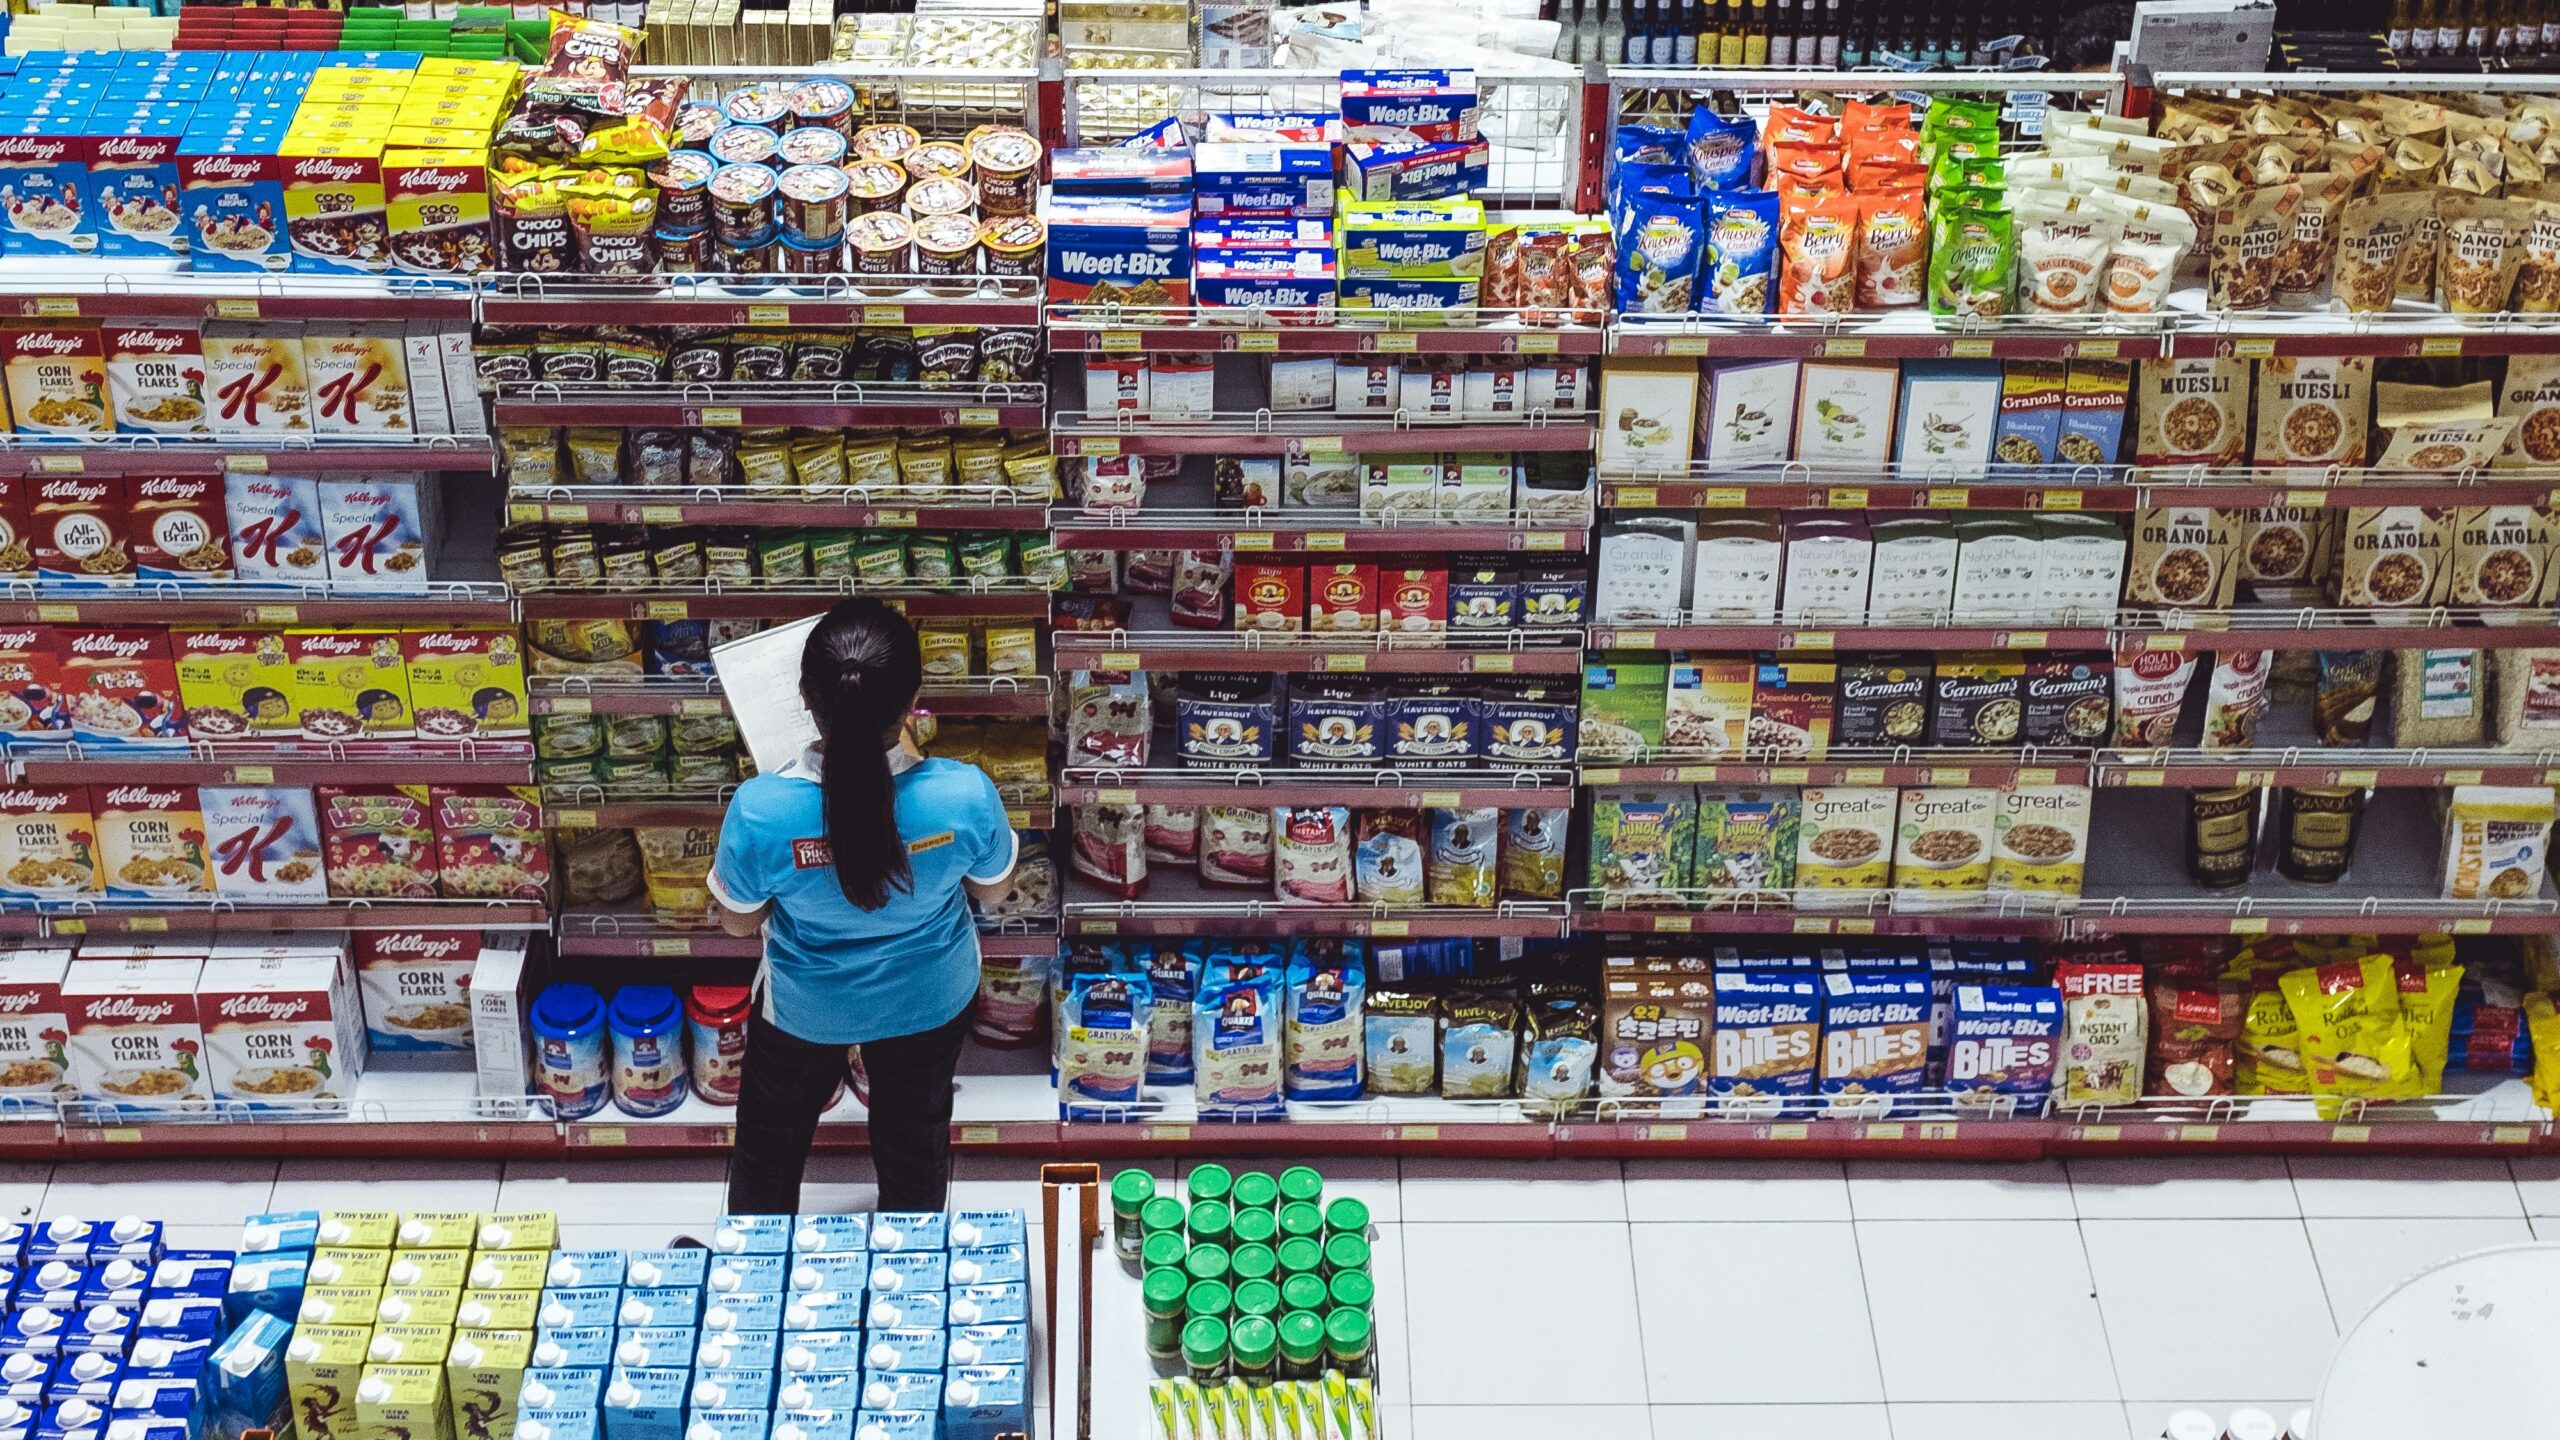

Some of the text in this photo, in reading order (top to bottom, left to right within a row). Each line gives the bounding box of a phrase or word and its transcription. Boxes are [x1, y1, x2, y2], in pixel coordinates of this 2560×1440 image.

[572, 32, 619, 48] CHOCO
[564, 40, 620, 65] CHIPS
[534, 92, 562, 104] Tinggi
[1369, 104, 1450, 122] Weet-Bix
[1234, 116, 1315, 130] Weet-Bix
[99, 138, 166, 160] Kellogg's
[193, 156, 261, 178] Kellogg's
[295, 158, 363, 180] Kellogg's
[400, 168, 468, 190] Kellogg's
[314, 192, 356, 204] COCO
[1232, 193, 1295, 207] Weet-Bix
[418, 203, 460, 215] COCO
[516, 218, 563, 230] CHOCO
[512, 232, 567, 250] CHIPS
[592, 236, 637, 247] CHOCO
[1231, 229, 1294, 240] Weet-Bix
[1639, 231, 1690, 252] Knusper
[1712, 226, 1767, 245] Knusper
[1803, 231, 1845, 251] Berry
[1870, 228, 1913, 246] Berry
[588, 247, 644, 264] CHIPS
[1380, 243, 1450, 259] Weet-Bix
[1950, 243, 2003, 265] Original
[2462, 247, 2499, 259] BITES
[1061, 250, 1174, 276] Weet-Bix
[1225, 287, 1309, 306] Weet-Bix
[1374, 292, 1444, 308] Weet-Bix
[16, 332, 83, 354] Kellogg's
[118, 330, 184, 352] Kellogg's
[37, 365, 72, 377] CORN
[135, 363, 177, 377] CORN
[212, 358, 257, 371] Special
[312, 358, 356, 371] Special
[39, 376, 74, 387] FLAKES
[138, 376, 180, 388] FLAKES
[2160, 376, 2230, 394] MUESLI
[217, 363, 283, 426] K
[317, 363, 382, 425] K
[2280, 383, 2351, 399] MUESLI
[2002, 392, 2062, 408] Granola
[2065, 393, 2124, 407] Granola
[2006, 419, 2046, 433] Blueberry
[2069, 418, 2108, 433] Blueberry
[2412, 432, 2485, 443] MUESLI
[41, 481, 108, 501] Kellogg's
[141, 480, 205, 499] Kellogg's
[236, 502, 279, 516] Special
[332, 512, 376, 524] Special
[64, 532, 100, 547] Bran
[70, 524, 94, 540] All-
[163, 530, 200, 543] Bran
[240, 509, 300, 568] K
[2142, 527, 2229, 545] GRANOLA
[2353, 530, 2442, 549] GRANOLA
[2462, 528, 2549, 546] GRANOLA
[336, 515, 400, 575] K
[657, 543, 695, 562] ENERGEN
[766, 543, 803, 562] ENERGEN
[708, 550, 746, 559] ENERGEN
[861, 550, 898, 565] ENERGEN
[1609, 545, 1674, 562] Granola
[72, 634, 149, 656] Kellogg's
[187, 634, 245, 651] Kellogg's
[302, 636, 361, 654] Kellogg's
[419, 634, 479, 651] Kellogg's
[925, 637, 964, 647] ENERGEN
[991, 636, 1031, 647] ENERGEN
[1761, 671, 1785, 681] Kölln
[1844, 678, 1923, 697] Carman's
[1939, 678, 2018, 698] Carman's
[2029, 675, 2107, 696] Carman's
[1210, 690, 1239, 701] Ligo
[1323, 688, 1352, 699] Ligo
[1701, 694, 1748, 704] Chocolate
[1801, 693, 1833, 704] Cherry
[2137, 691, 2175, 704] crunch
[1193, 710, 1252, 719] HAVERMOUT
[1307, 709, 1365, 718] HAVERMOUT
[1403, 706, 1461, 715] HAVERMOUT
[1498, 711, 1556, 720] HAVERMOUT
[1222, 744, 1251, 755] COOKING
[1395, 759, 1467, 769] WHITE OATS
[107, 787, 180, 809] Kellogg's
[2007, 791, 2067, 814] great
[2294, 797, 2354, 810] GRANOLA
[1814, 799, 1873, 822] great
[1914, 799, 1973, 821] great
[211, 812, 264, 825] Special
[16, 824, 57, 836] CORN
[129, 821, 169, 833] CORN
[1618, 822, 1663, 839] JUNGLE
[19, 836, 59, 846] FLAKES
[131, 834, 172, 844] FLAKES
[911, 835, 952, 852] ENERGEN
[216, 815, 293, 883] K
[375, 934, 462, 957] Kellogg's
[398, 972, 445, 985] CORN
[2083, 973, 2143, 993] FREE
[400, 986, 447, 997] FLAKES
[1090, 991, 1126, 1001] QUAKER
[1306, 991, 1342, 1001] QUAKER
[86, 998, 172, 1021] Kellogg's
[220, 995, 307, 1021] Kellogg's
[480, 998, 506, 1008] CORN
[1986, 1001, 2032, 1013] Weet-Bix
[1221, 1016, 1255, 1026] QUAKER
[1717, 1004, 1811, 1024] Weet-Bix
[1828, 1003, 1923, 1024] Weet-Bix
[2323, 1006, 2369, 1026] Rolled
[1087, 1030, 1118, 1040] GRATIS
[1957, 1019, 2053, 1037] Weet-Bix
[2080, 1022, 2128, 1035] INSTANT
[111, 1036, 159, 1049] CORN
[245, 1034, 293, 1048] CORN
[2089, 1034, 2120, 1046] OATS
[114, 1050, 162, 1061] FLAKES
[248, 1048, 295, 1059] FLAKES
[1716, 1028, 1812, 1077] BITES
[1827, 1026, 1922, 1078] BITES
[1953, 1038, 2049, 1080] BITES
[334, 1211, 388, 1220] ULTRA MILK
[402, 1252, 459, 1260] ULTRA MILK
